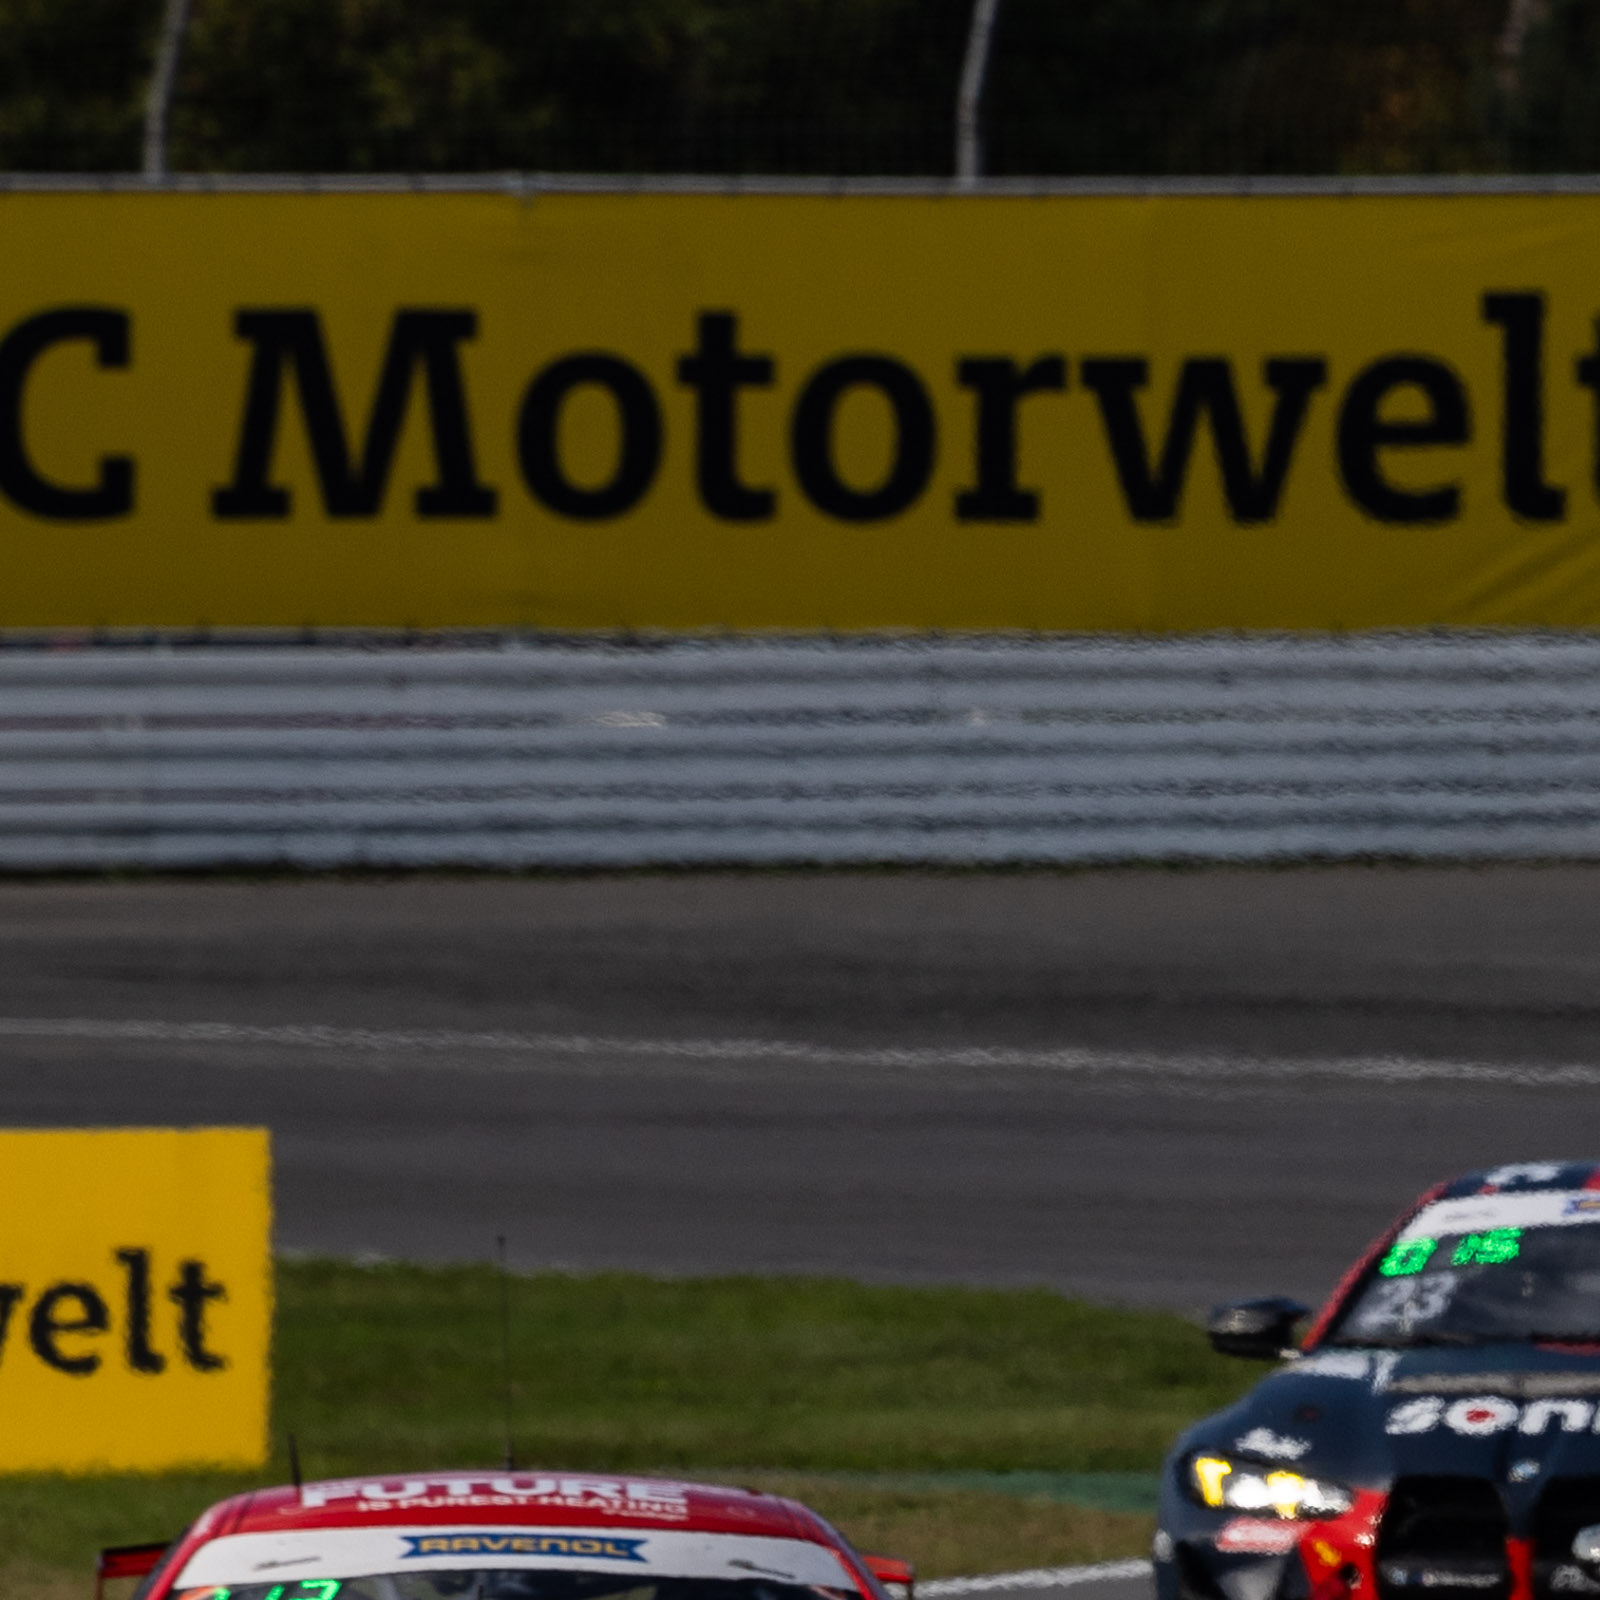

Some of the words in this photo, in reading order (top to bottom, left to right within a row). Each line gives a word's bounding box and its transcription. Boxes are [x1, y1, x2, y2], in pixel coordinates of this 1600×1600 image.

[0, 1245, 228, 1377] elt
[303, 1477, 689, 1508] FUTURE
[419, 1536, 631, 1557] RAVENOL
